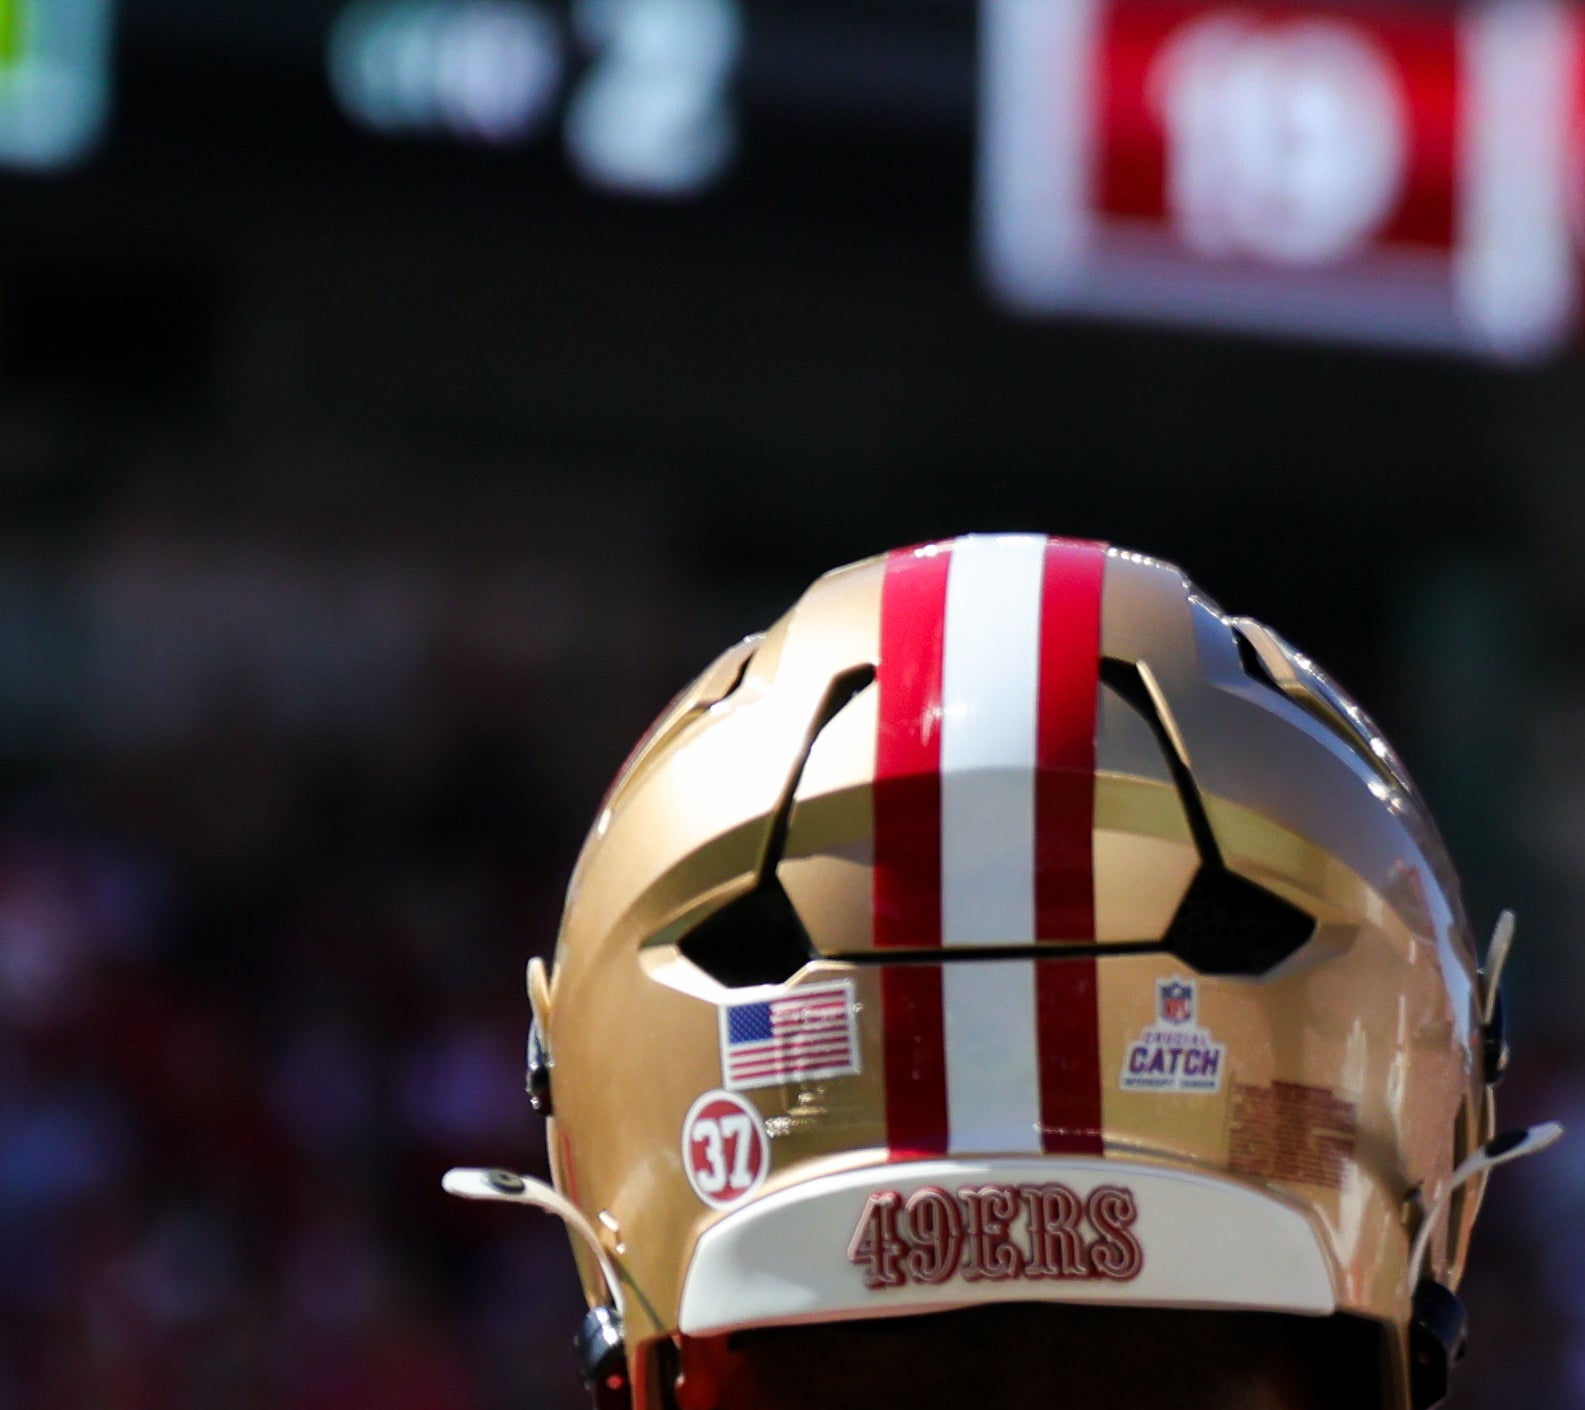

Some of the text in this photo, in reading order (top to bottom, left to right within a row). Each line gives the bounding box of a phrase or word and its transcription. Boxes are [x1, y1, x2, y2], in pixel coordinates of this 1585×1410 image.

[1148, 10, 1408, 266] 19
[1129, 1046, 1220, 1076] CATCH
[692, 1113, 752, 1195] 37
[848, 1184, 1144, 1289] 49ERS
